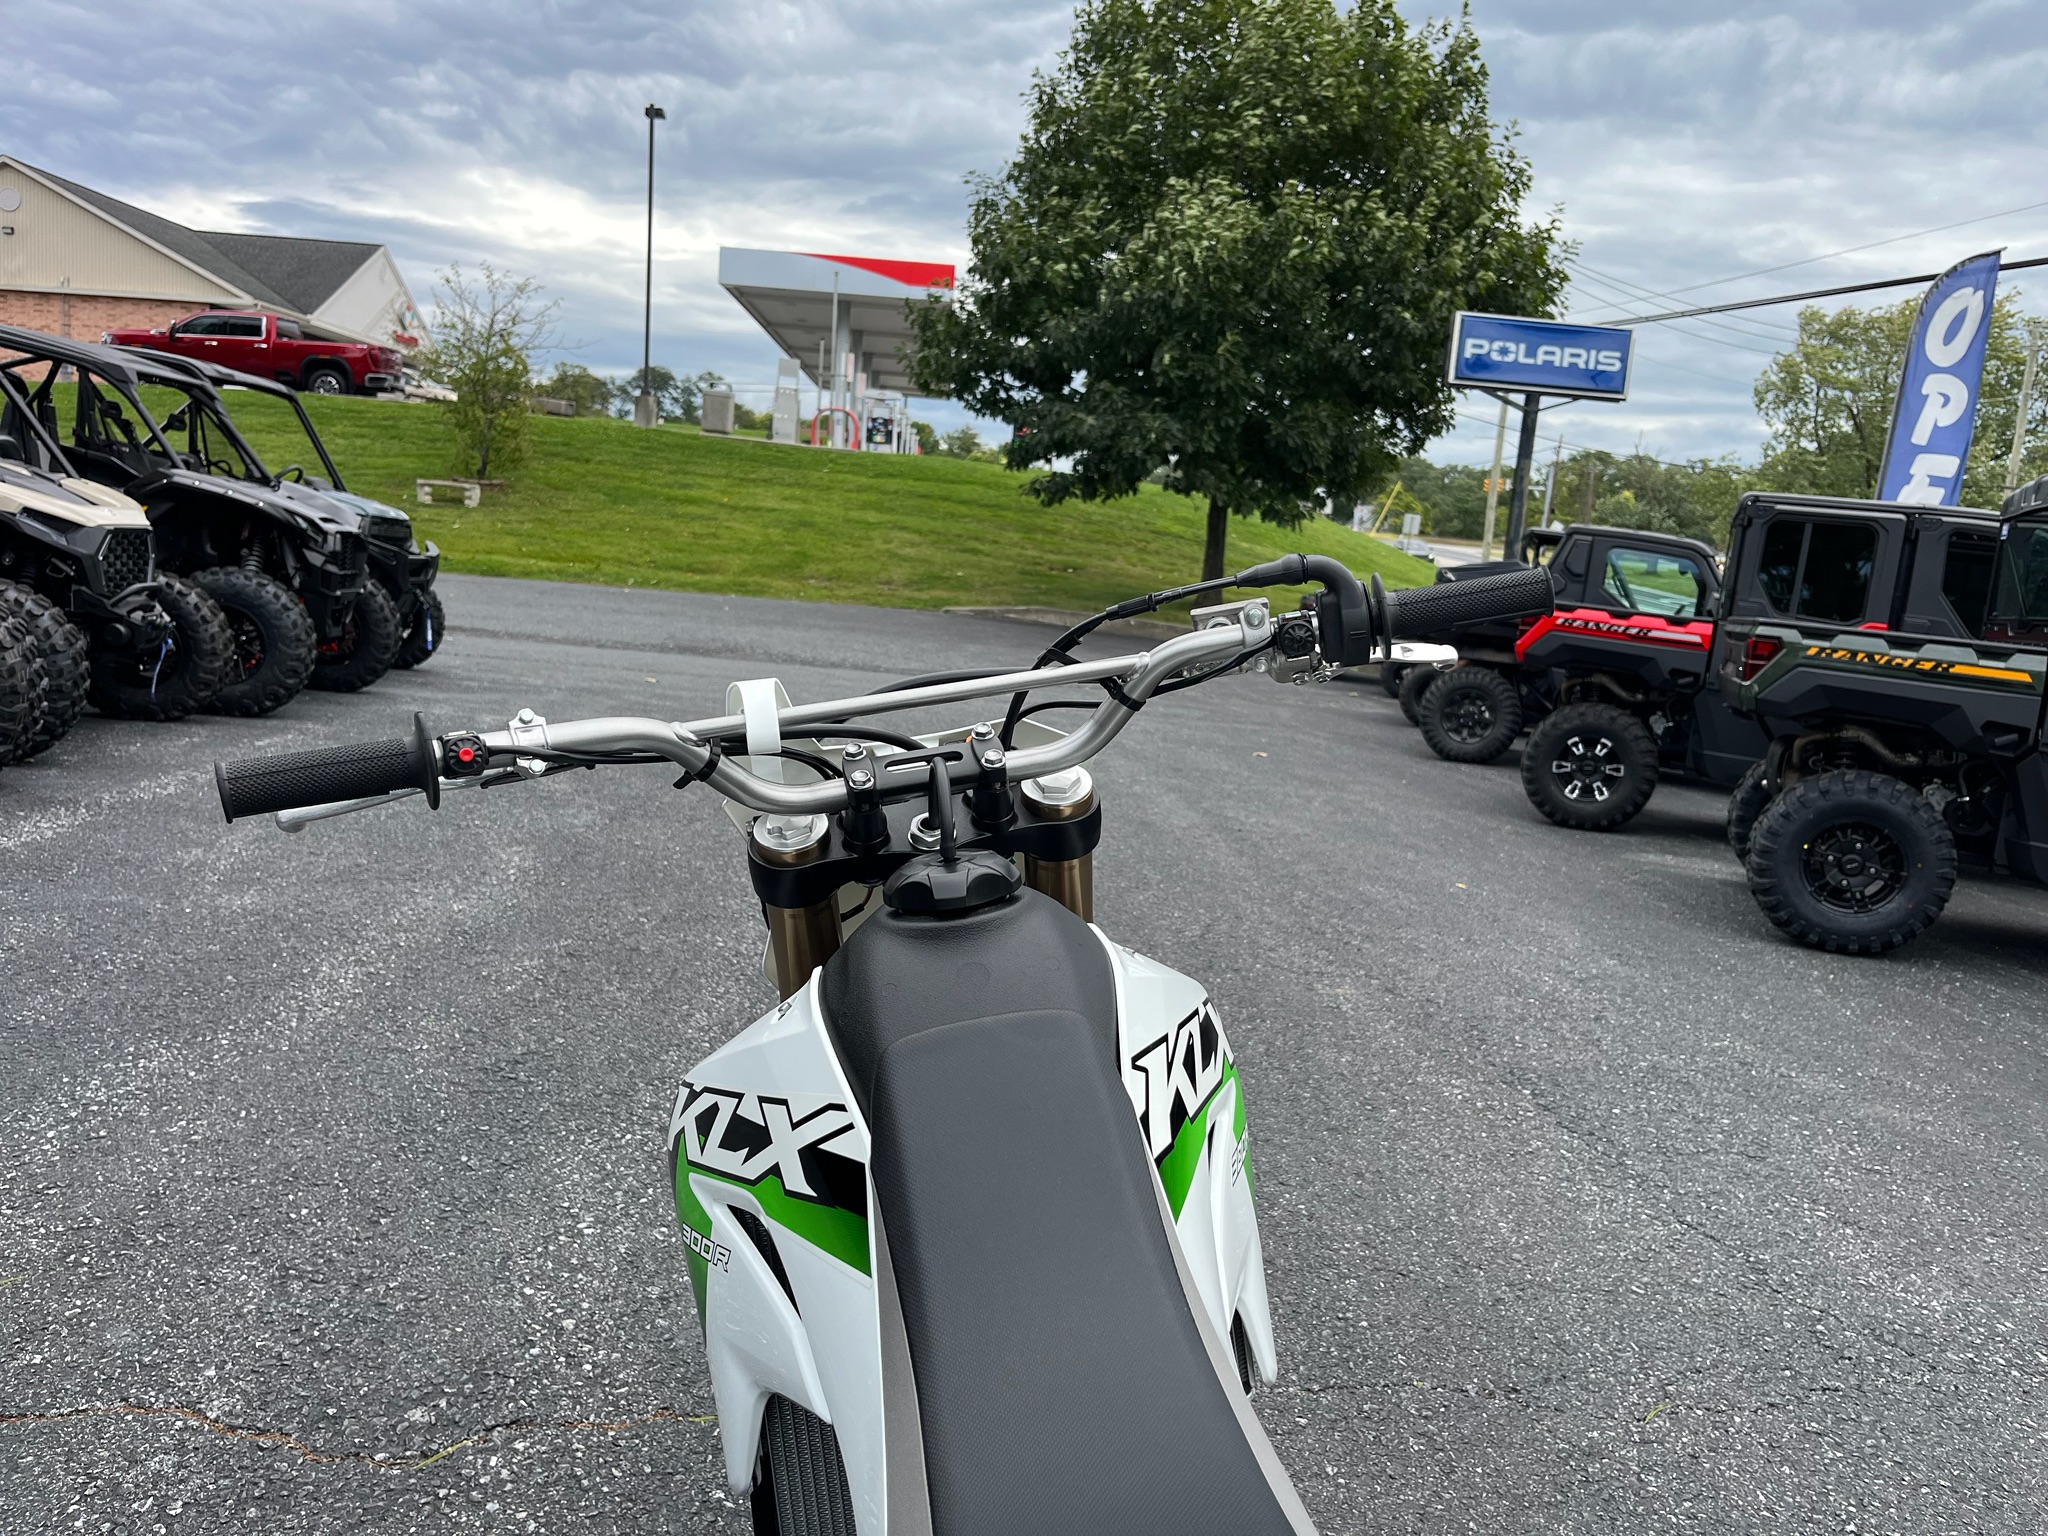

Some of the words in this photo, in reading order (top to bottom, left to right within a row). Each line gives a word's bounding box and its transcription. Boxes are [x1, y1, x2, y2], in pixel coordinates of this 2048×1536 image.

[1463, 337, 1623, 372] POLARIS
[1556, 617, 1654, 636] RANGER
[1806, 646, 1957, 672] RANGER
[667, 1080, 855, 1198] KLX
[682, 1221, 731, 1273] 300R
